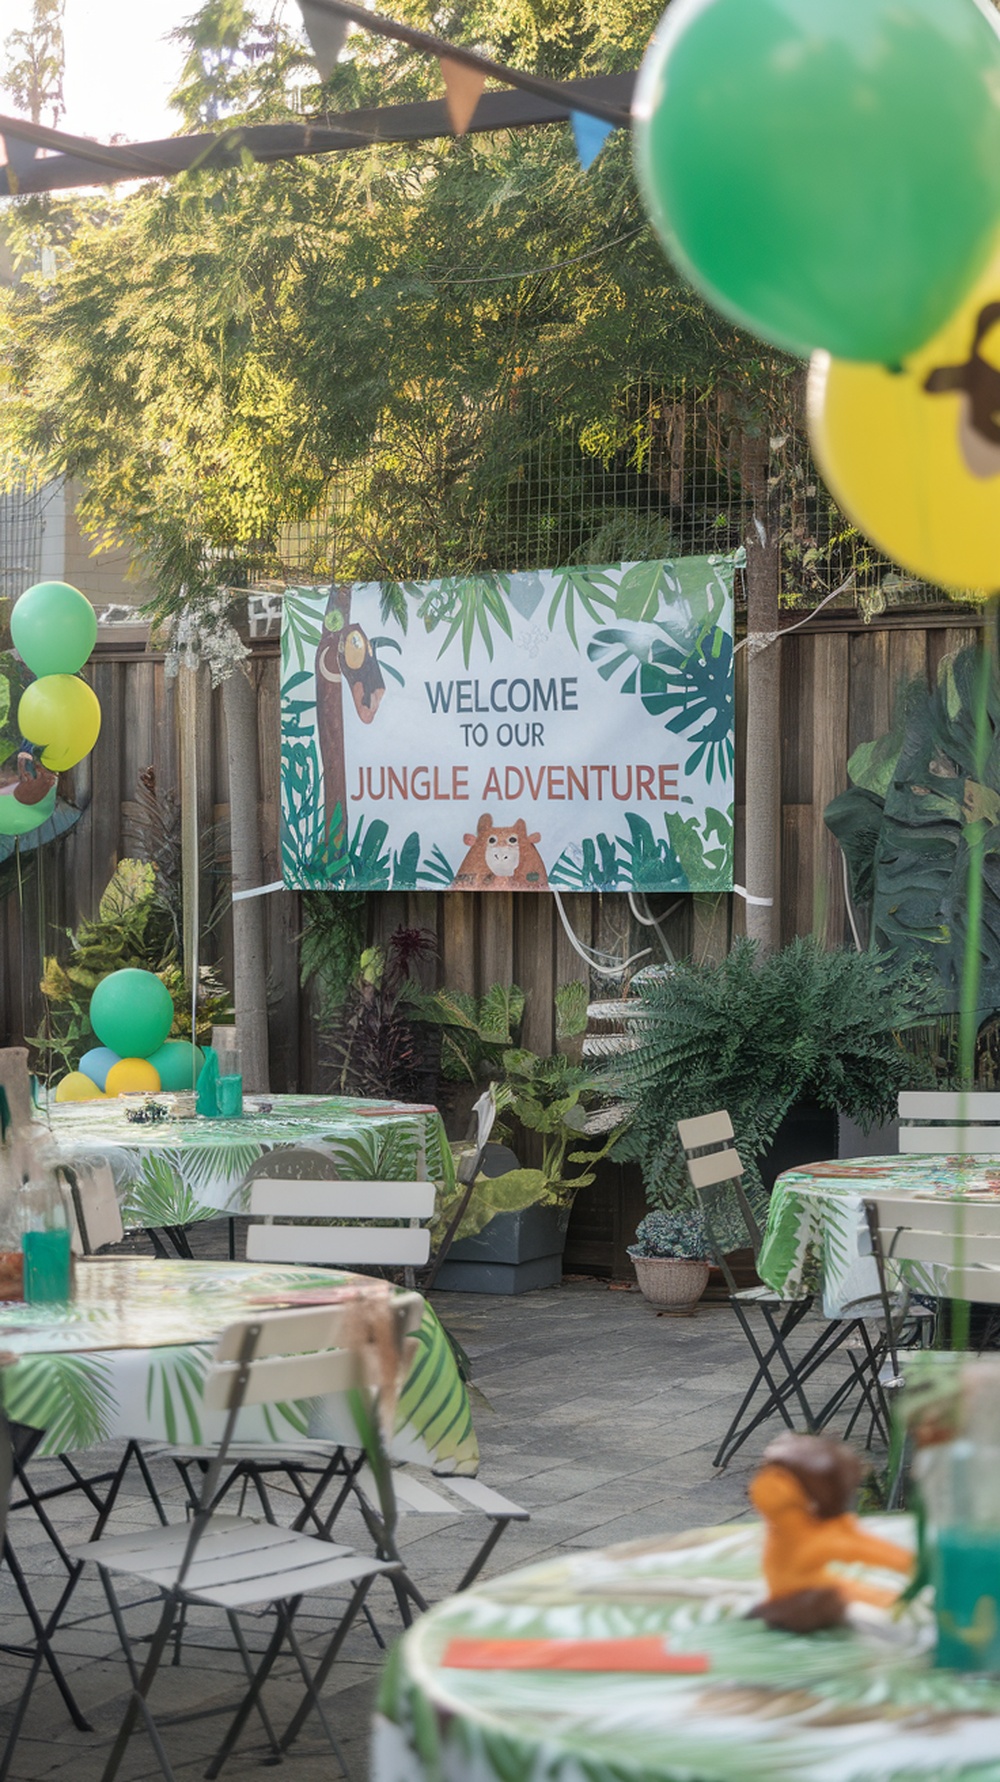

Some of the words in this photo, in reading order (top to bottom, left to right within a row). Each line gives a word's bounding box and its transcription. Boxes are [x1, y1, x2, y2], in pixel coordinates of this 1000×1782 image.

[425, 677, 578, 713] WELCOME
[460, 723, 488, 747] TO
[496, 723, 545, 747] OUR
[351, 766, 469, 801] JUNGLE
[482, 763, 679, 801] ADVENTURE
